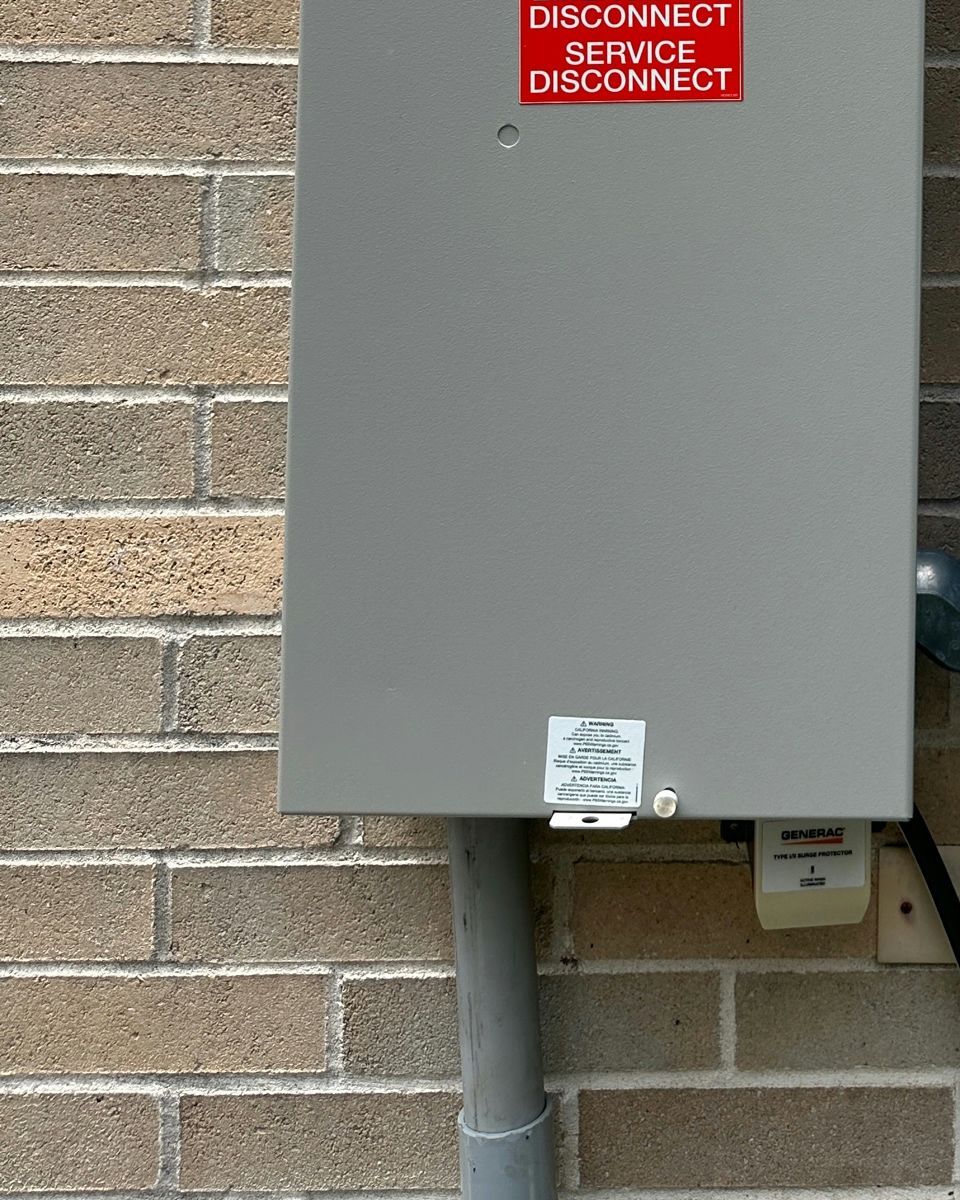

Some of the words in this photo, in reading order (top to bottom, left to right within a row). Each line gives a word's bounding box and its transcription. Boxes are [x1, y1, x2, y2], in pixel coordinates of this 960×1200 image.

[530, 3, 732, 29] DISCONNECT
[565, 40, 696, 66] SERVICE
[530, 67, 733, 94] DISCONNECT
[781, 827, 844, 841] GENERAC
[818, 849, 853, 857] PROTECTOR
